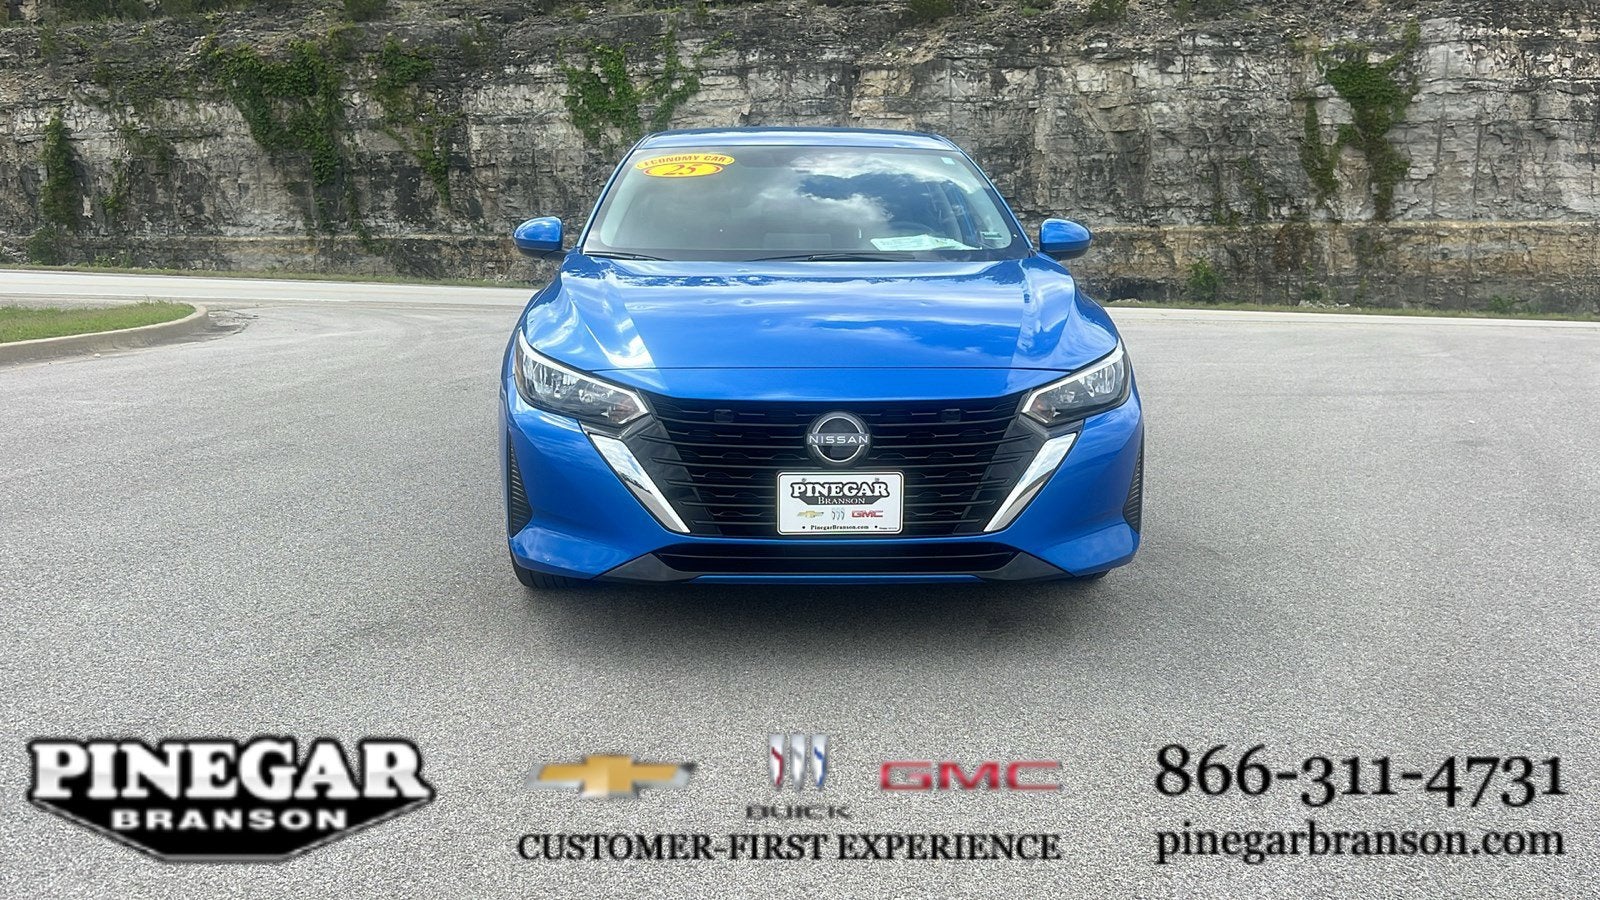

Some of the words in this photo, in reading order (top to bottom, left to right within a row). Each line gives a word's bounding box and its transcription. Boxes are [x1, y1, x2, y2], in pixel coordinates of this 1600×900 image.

[644, 155, 699, 166] ECONOMY
[663, 163, 702, 175] 25
[809, 435, 868, 444] NISSAN
[791, 483, 889, 497] PINEGAR
[851, 510, 884, 518] GMC
